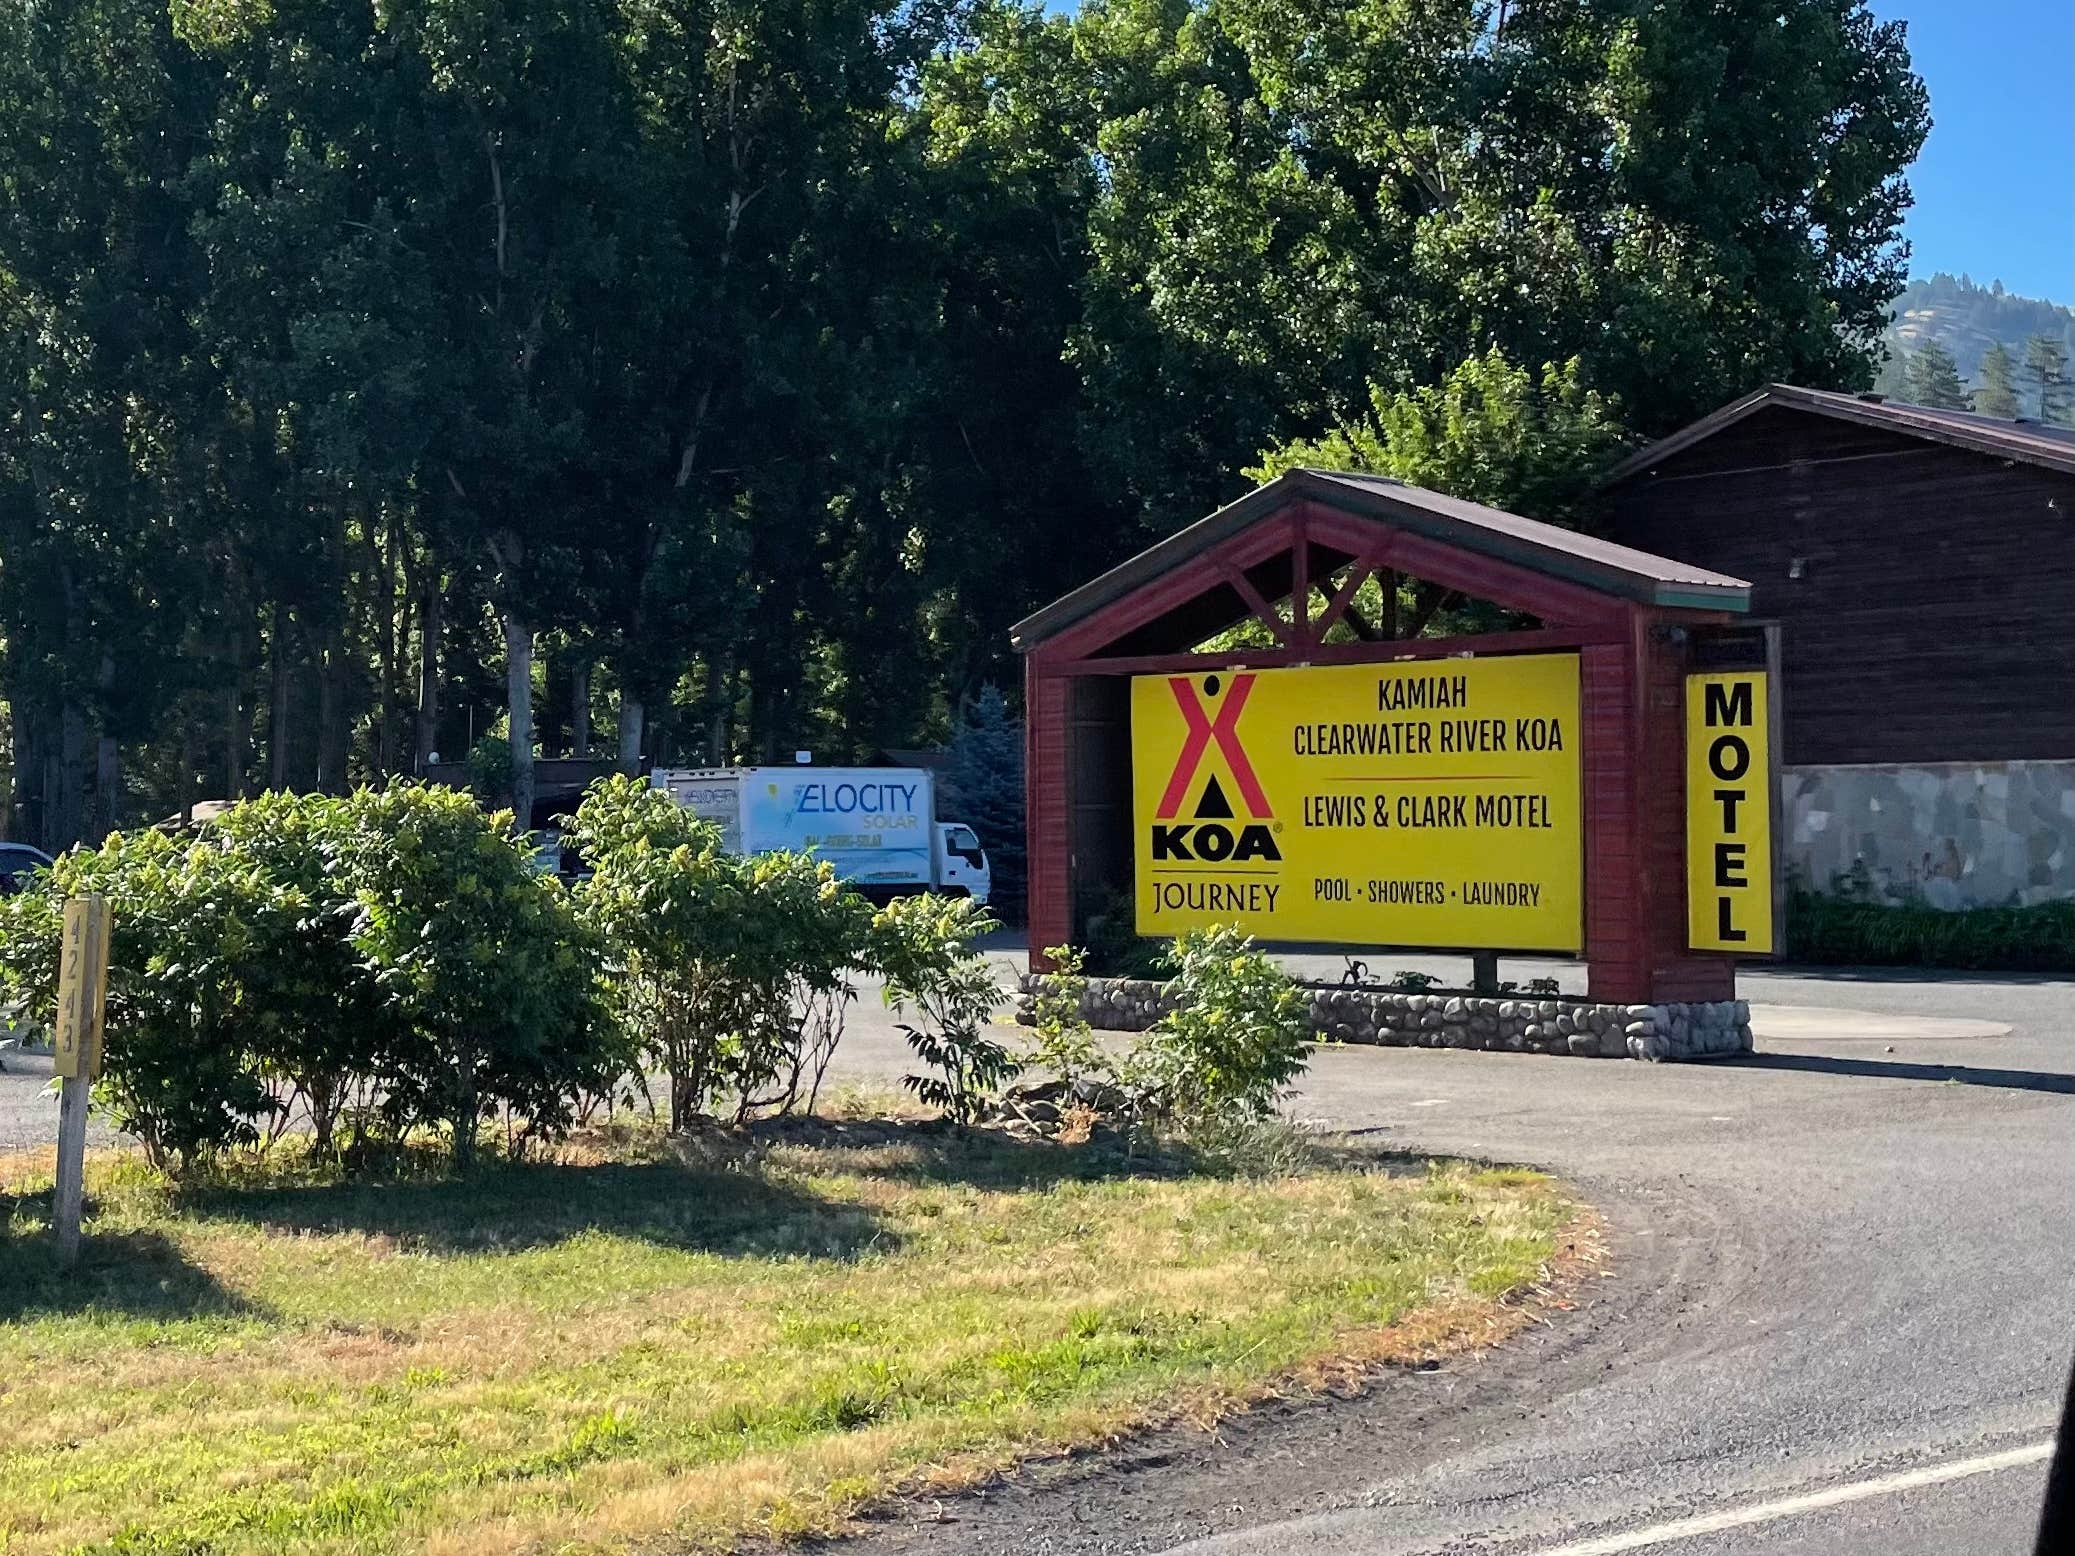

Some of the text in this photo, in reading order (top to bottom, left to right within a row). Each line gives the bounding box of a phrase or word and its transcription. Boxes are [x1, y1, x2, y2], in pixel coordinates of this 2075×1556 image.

[1378, 676, 1467, 711] KAMIAH
[1294, 718, 1563, 755] CLEARWATER RIVER KOA
[863, 815, 918, 829] SOLAR
[1304, 795, 1552, 828] LEWIS & CLARK MOTEL
[1704, 682, 1753, 942] MOTEL
[1151, 823, 1283, 862] KOA
[1153, 882, 1280, 913] JOURNEY
[1314, 878, 1540, 907] POOL SHOWERS LAUNDRY
